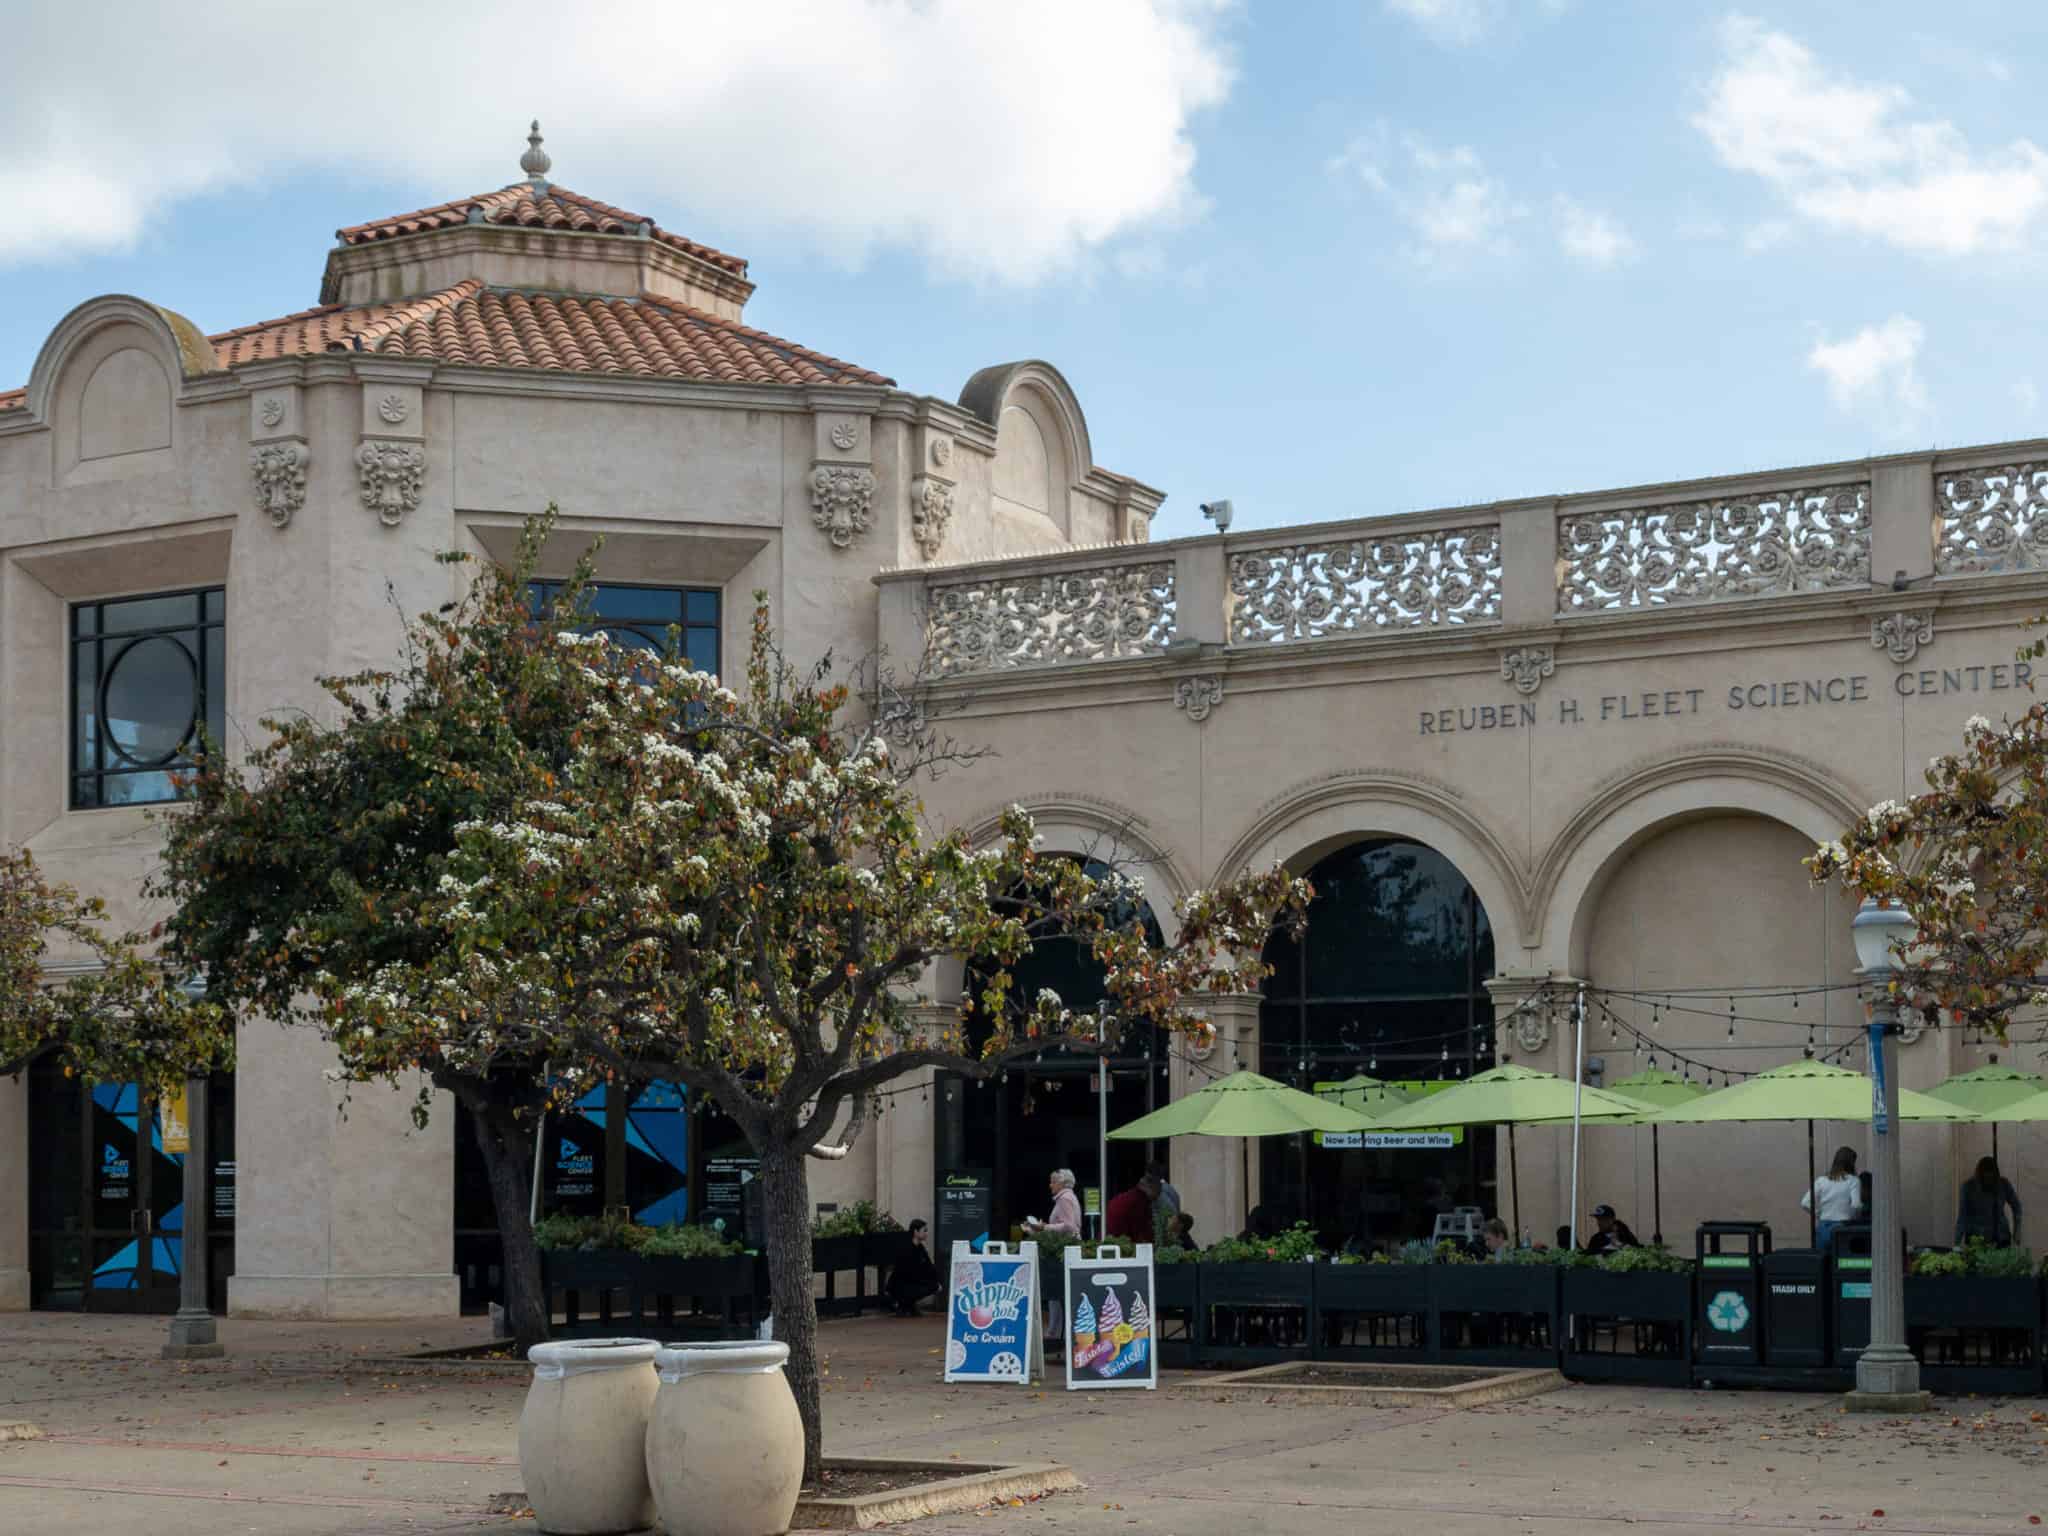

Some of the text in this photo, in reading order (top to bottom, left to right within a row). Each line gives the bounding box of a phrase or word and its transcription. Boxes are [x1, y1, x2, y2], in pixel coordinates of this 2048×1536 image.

[1419, 663, 2033, 735] REUBEN H. FLEET SCIENCE CENTER
[1324, 1135, 1344, 1145] Now
[1383, 1135, 1404, 1145] Beer
[1407, 1135, 1425, 1145] and
[1427, 1135, 1451, 1145] Wine
[963, 1331, 1016, 1344] Ice Cream
